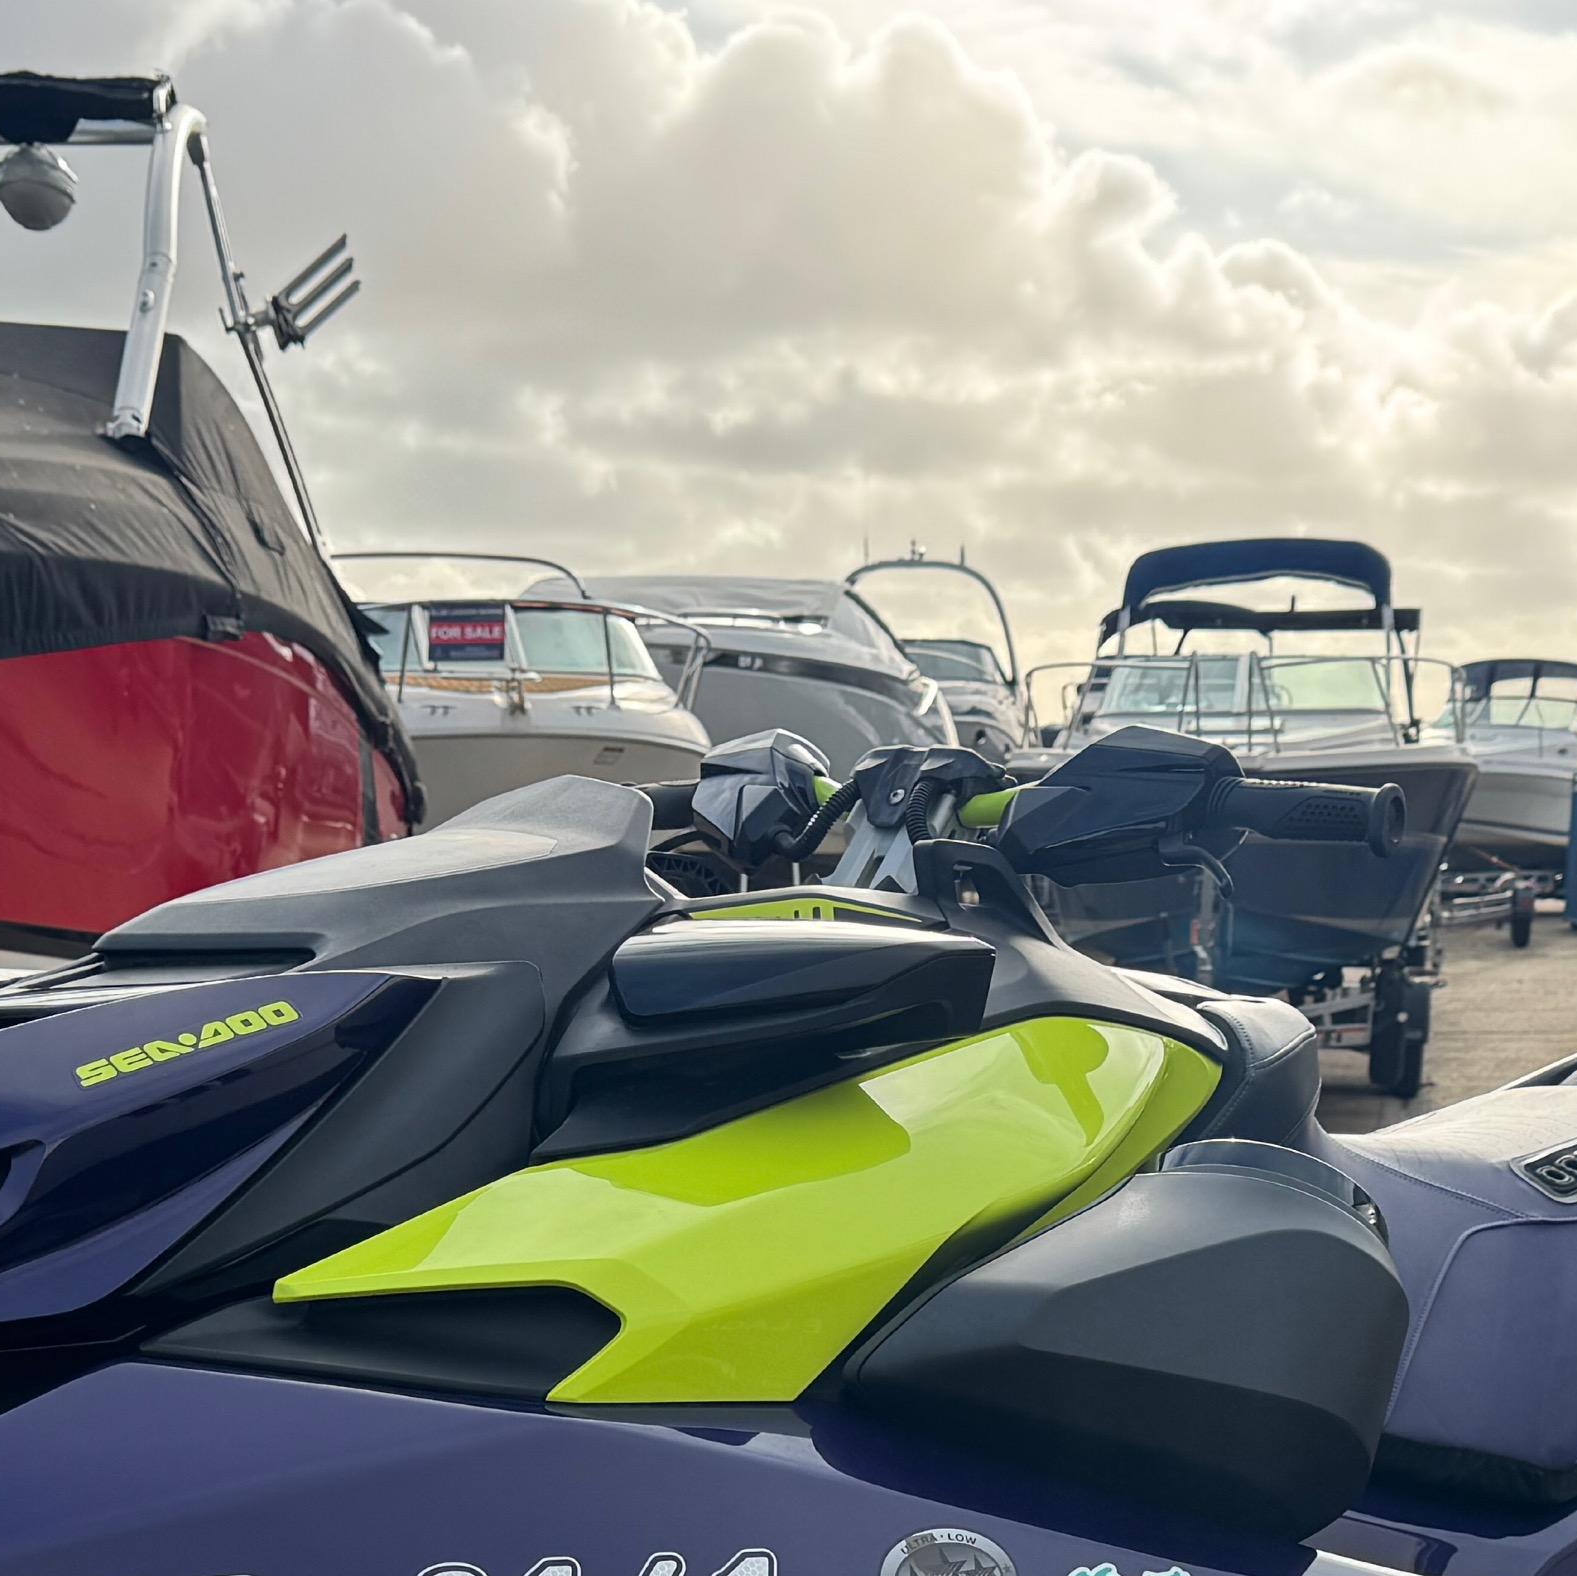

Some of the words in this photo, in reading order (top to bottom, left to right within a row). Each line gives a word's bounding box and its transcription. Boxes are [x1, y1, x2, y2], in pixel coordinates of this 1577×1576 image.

[431, 626, 461, 640] FOR
[464, 626, 501, 640] SALE
[900, 1533, 937, 1554] ULTRA
[948, 1533, 977, 1545] LOW
